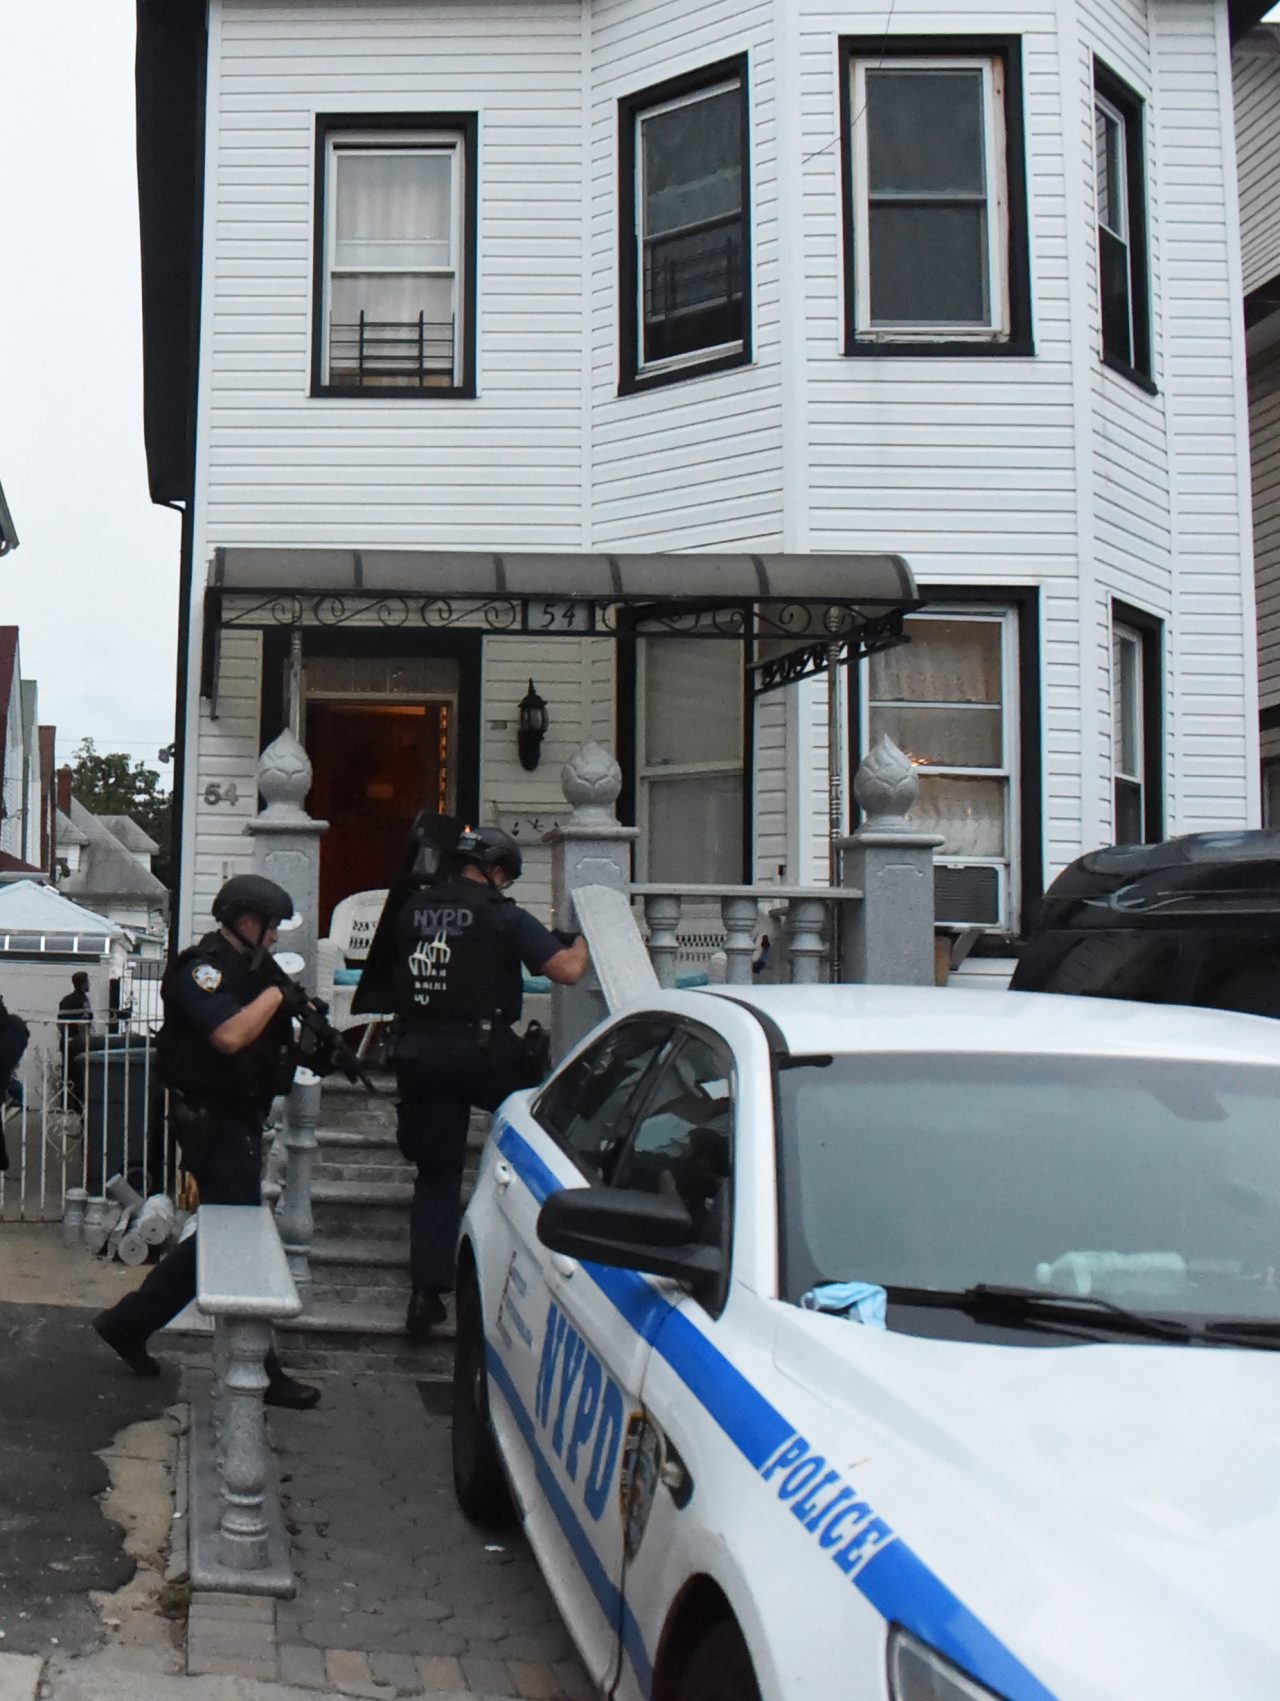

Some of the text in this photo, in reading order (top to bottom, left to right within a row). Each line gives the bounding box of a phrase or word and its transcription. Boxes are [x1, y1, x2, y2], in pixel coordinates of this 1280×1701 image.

[540, 601, 576, 628] 54
[413, 908, 473, 928] NYPD
[535, 1302, 626, 1522] NYPD
[760, 1433, 894, 1577] POLICE
